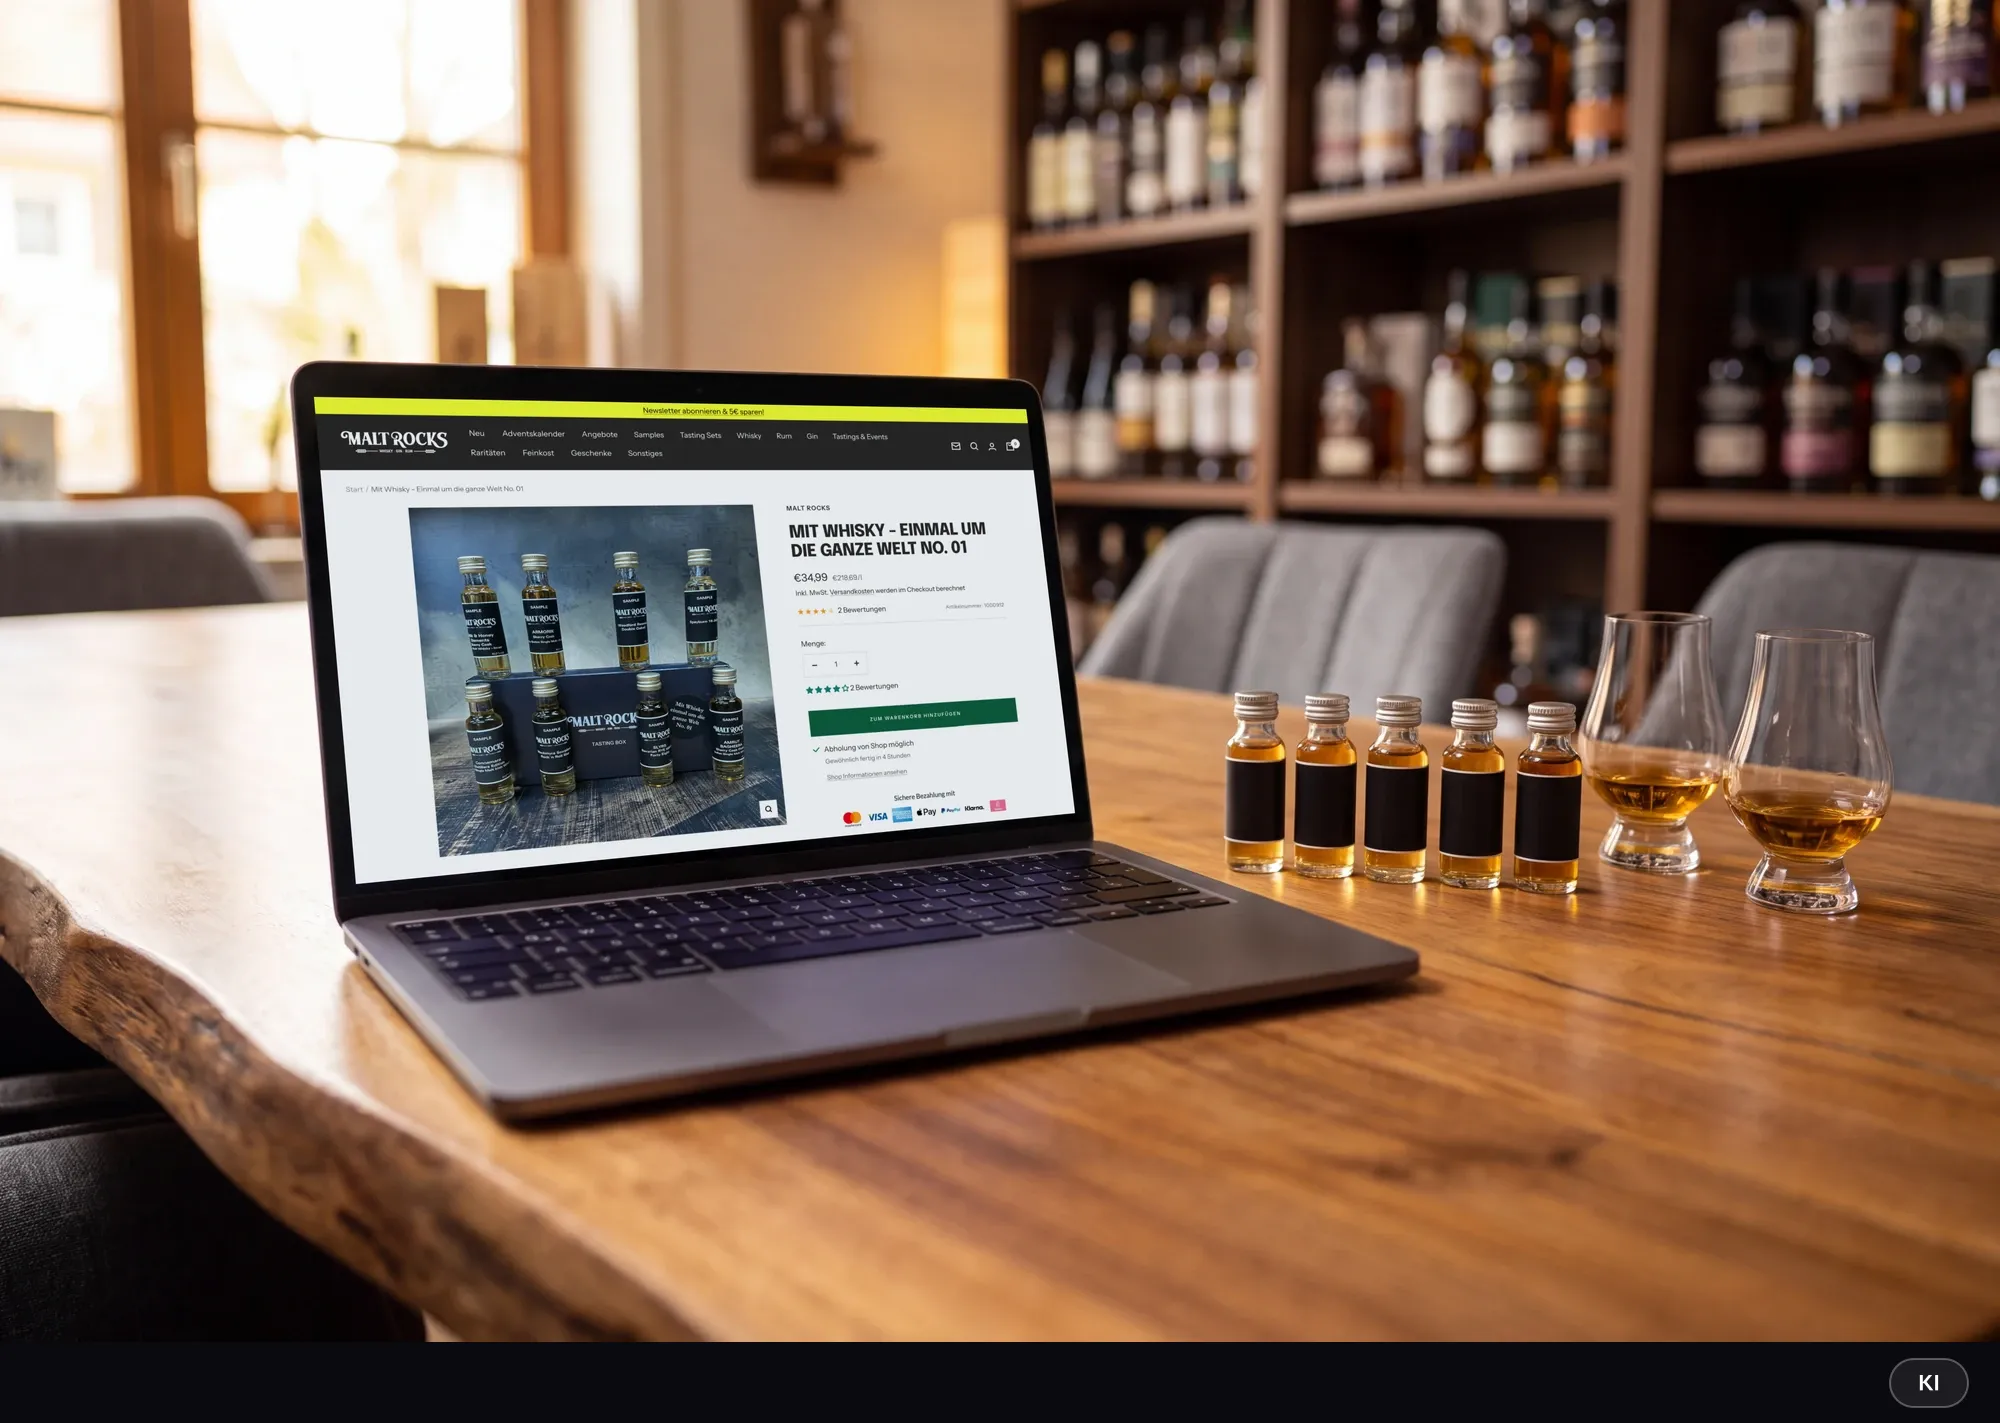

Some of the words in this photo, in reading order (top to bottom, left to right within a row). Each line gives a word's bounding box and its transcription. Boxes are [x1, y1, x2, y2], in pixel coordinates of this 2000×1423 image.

[643, 407, 680, 415] Newsletter
[723, 408, 728, 416] &
[729, 408, 738, 416] 5€
[740, 409, 764, 418] sparen!
[341, 431, 389, 445] MALT
[391, 431, 448, 448] ROCKS
[502, 430, 565, 438] Adventskalender
[582, 431, 618, 439] Angebote
[634, 431, 664, 440] Samples
[680, 432, 705, 441] Tasting
[737, 432, 762, 441] Whisky
[832, 433, 858, 441] Tastings
[471, 449, 506, 457] Raritäten
[523, 449, 554, 457] Feinkost
[628, 449, 663, 458] Sonstiges
[384, 486, 410, 494] Whisky
[789, 524, 818, 538] MIT
[822, 523, 885, 538] WHISKY
[900, 522, 958, 536] EINMAL
[961, 522, 986, 535] UM
[791, 543, 816, 557] DIE
[820, 542, 873, 556] GANZE
[876, 541, 916, 555] WELT
[921, 541, 948, 554] NO.
[951, 540, 967, 554] 01
[793, 573, 828, 583] €34,99
[829, 588, 874, 596] Versandkosten
[843, 605, 886, 614] Bewertungen
[473, 618, 496, 627] ROCKS
[801, 640, 826, 648] Menge:
[856, 682, 899, 691] Bewertungen
[567, 714, 603, 728] MALT
[824, 744, 857, 753] Abholung
[870, 741, 887, 750] Shop
[888, 740, 914, 749] möglich
[825, 756, 859, 764] Gewöhnlich
[859, 754, 876, 762] fertig
[843, 770, 882, 779] Informationen
[894, 794, 915, 802] Sichere
[916, 791, 945, 800] Bezahlung
[868, 812, 888, 821] VISA
[923, 808, 936, 816] Pay
